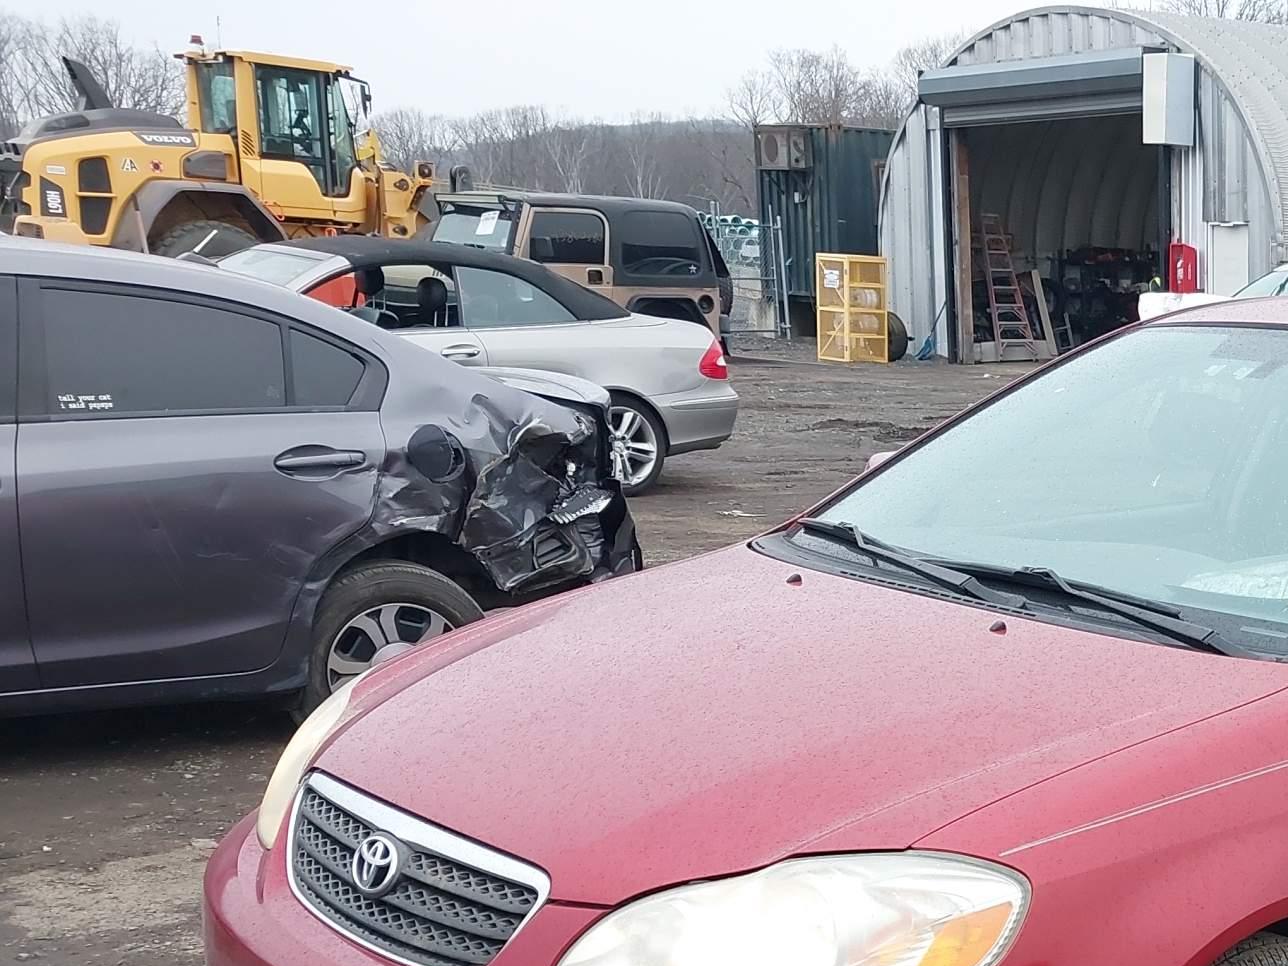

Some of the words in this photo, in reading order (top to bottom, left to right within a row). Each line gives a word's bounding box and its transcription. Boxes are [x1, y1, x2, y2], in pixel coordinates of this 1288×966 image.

[141, 134, 192, 144] VOLVO
[46, 190, 63, 214] L90H
[77, 395, 95, 403] your
[69, 401, 86, 409] said
